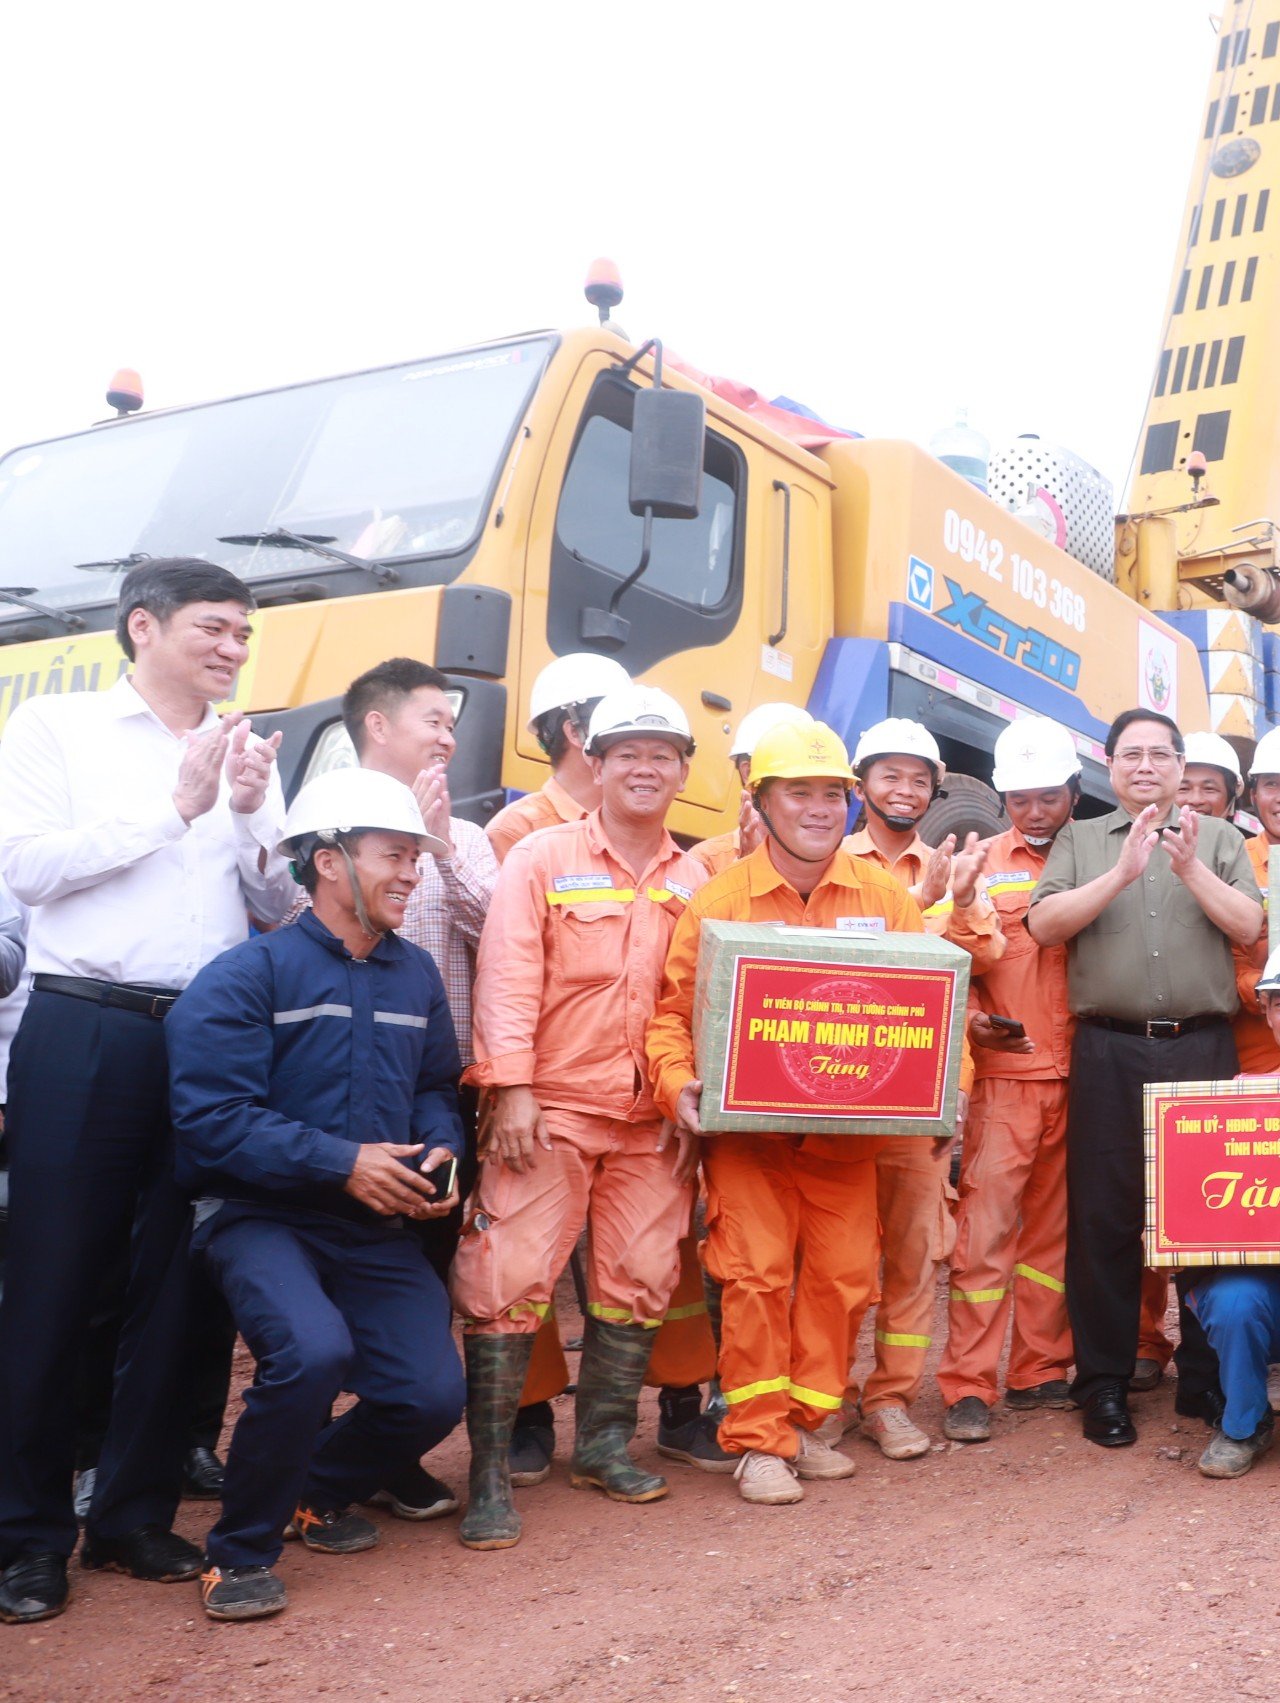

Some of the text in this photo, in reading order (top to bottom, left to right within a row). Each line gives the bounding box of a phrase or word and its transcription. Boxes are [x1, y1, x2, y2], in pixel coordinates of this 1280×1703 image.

[943, 508, 1086, 633] 0942 103 368
[933, 573, 1082, 692] XCT300
[805, 998, 829, 1012] CHÍNH
[887, 1004, 909, 1017] CHÍNH
[748, 1017, 934, 1049] PHẠM MINH CHÍNH
[809, 1055, 871, 1080] Tặng
[1175, 1115, 1201, 1134] TỈNH
[1224, 1138, 1250, 1156] TỈNH
